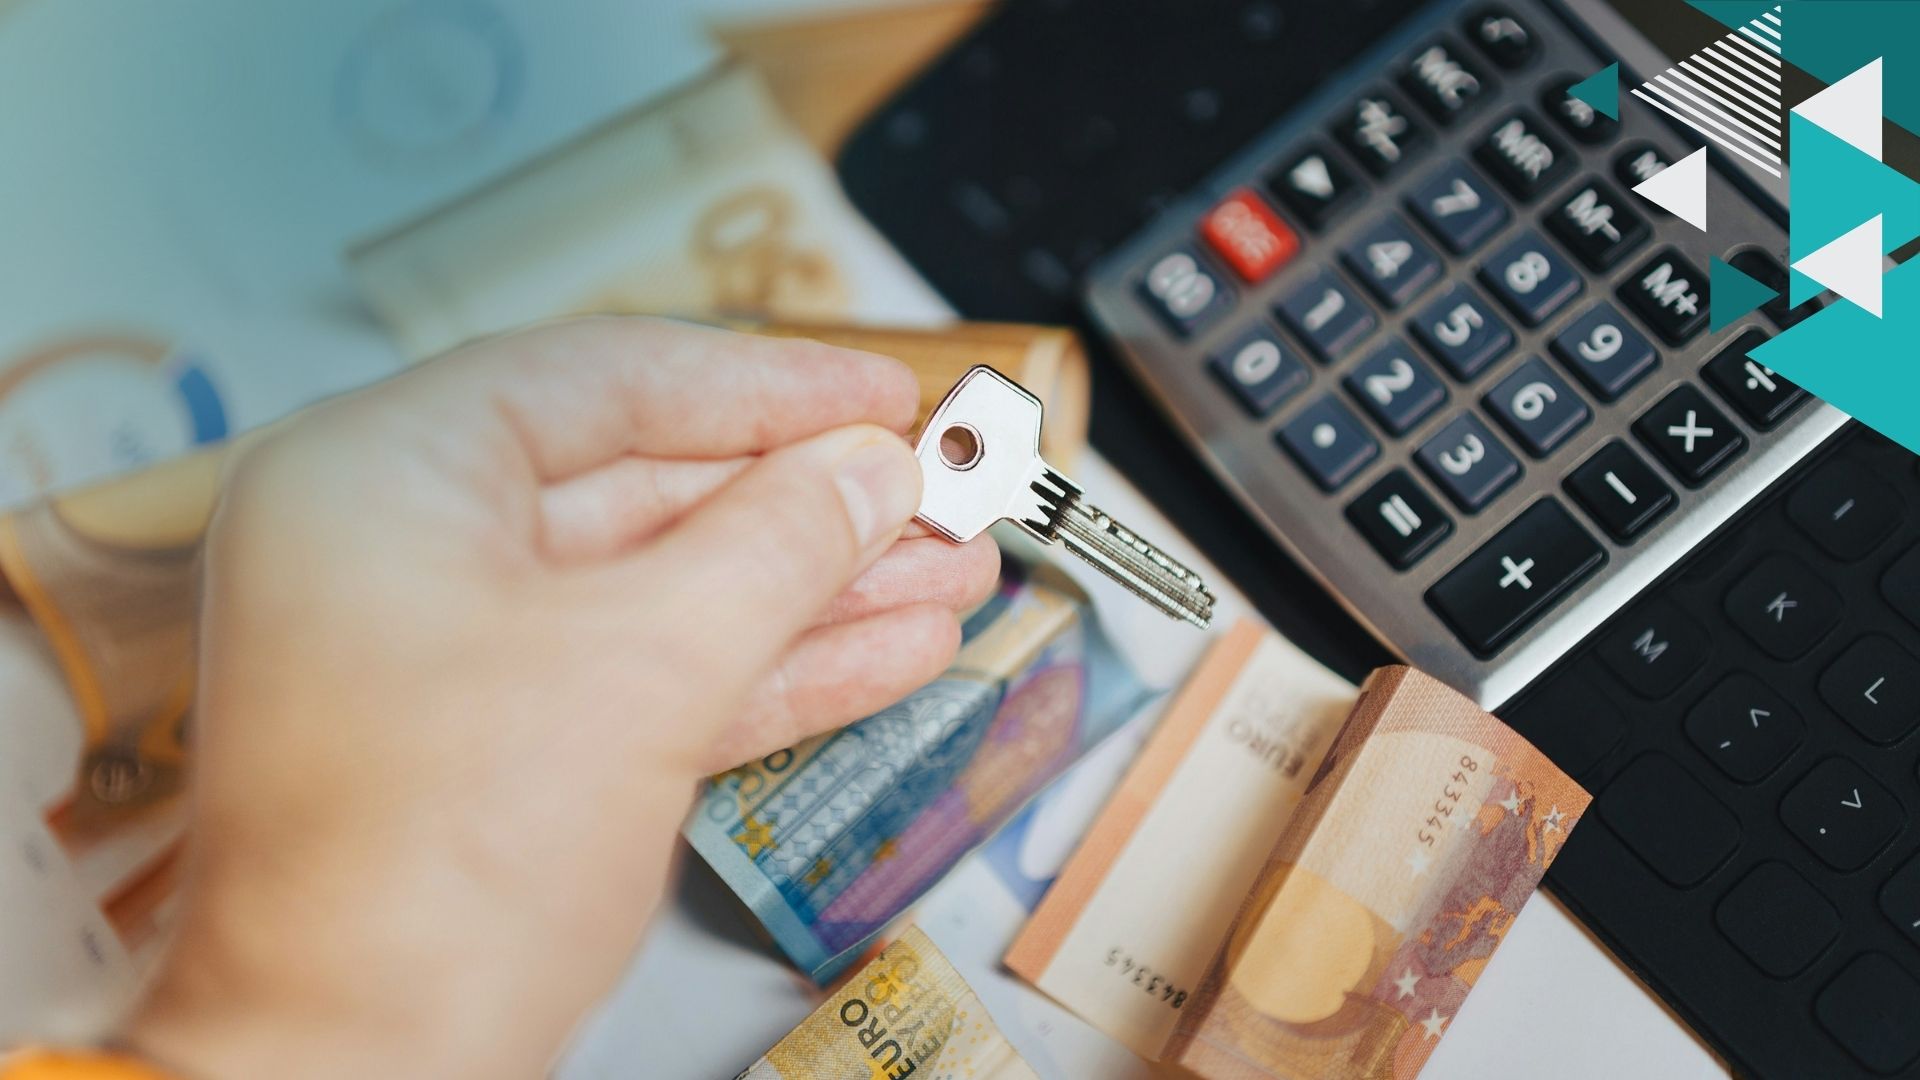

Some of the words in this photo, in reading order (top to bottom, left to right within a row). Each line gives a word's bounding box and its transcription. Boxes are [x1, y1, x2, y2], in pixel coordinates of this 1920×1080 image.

[1493, 118, 1554, 180] MR
[1434, 180, 1479, 215] 7
[1370, 241, 1411, 277] 4
[1507, 252, 1550, 292] 8
[1641, 262, 1699, 316] M+
[1306, 290, 1344, 329] 1
[1436, 304, 1483, 345] 5
[1234, 341, 1280, 384] 0
[1580, 325, 1622, 361] 9
[1365, 357, 1415, 406] 2
[1513, 382, 1556, 419] 6
[1440, 434, 1484, 474] 3
[1768, 593, 1796, 621] K
[1635, 630, 1667, 662] M
[1865, 677, 1884, 704] L
[1417, 755, 1478, 848] 843345
[1103, 946, 1188, 1009] 843345
[840, 999, 917, 1080] EURO
